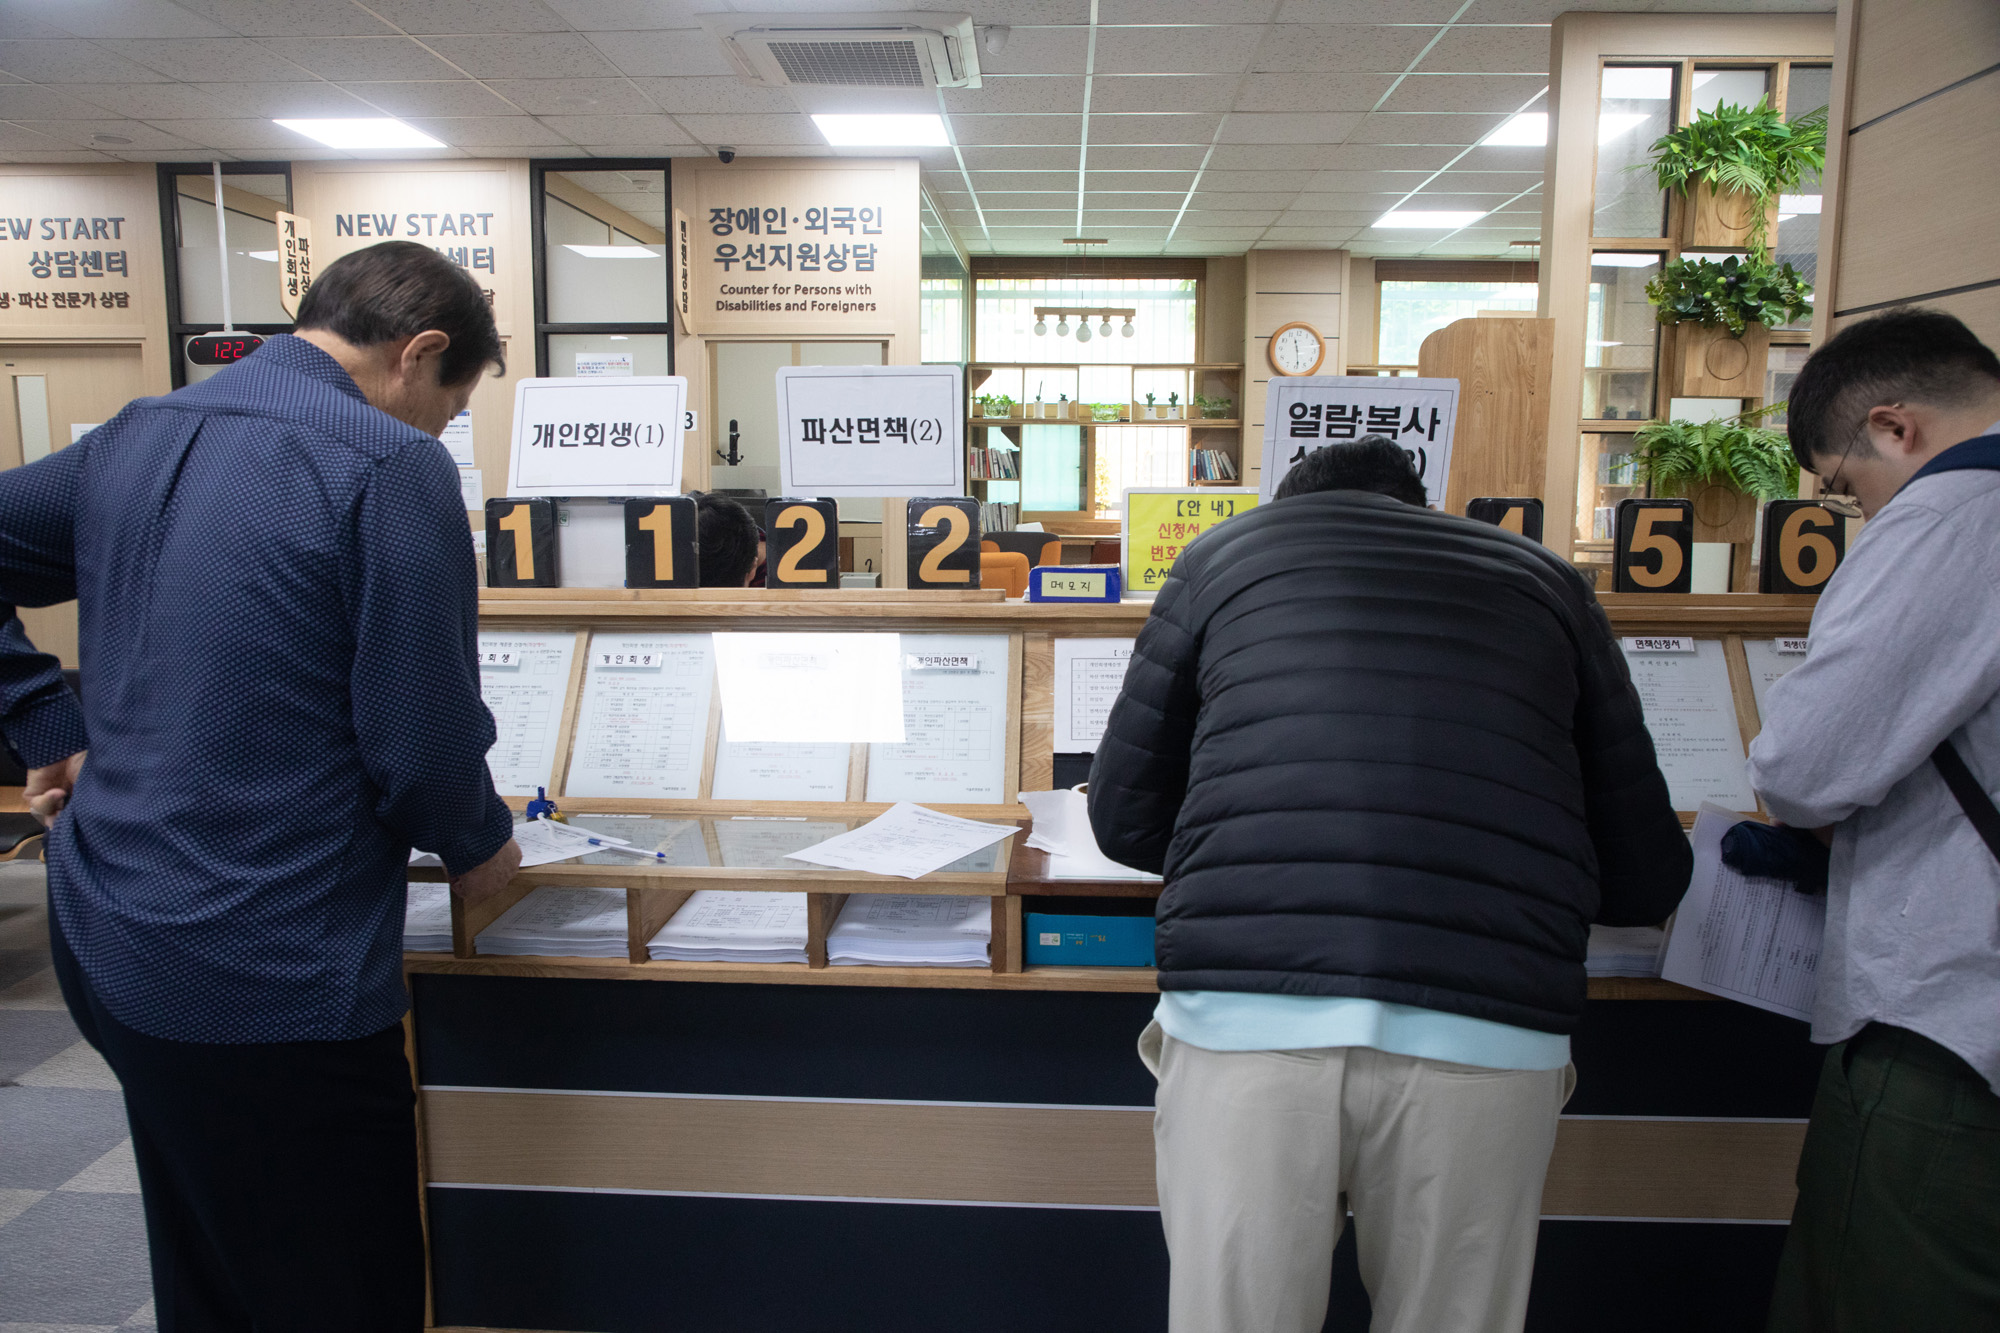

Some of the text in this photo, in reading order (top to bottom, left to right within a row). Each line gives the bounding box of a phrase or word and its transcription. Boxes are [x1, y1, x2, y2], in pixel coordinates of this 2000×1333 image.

[40, 217, 125, 240] START
[336, 213, 493, 237] NEW START
[709, 206, 883, 236] 장애인·외국인
[28, 250, 128, 279] 상담센터
[284, 220, 298, 297] 개인회생
[713, 243, 878, 272] 우선지원상담
[51, 291, 97, 309] 전문가
[100, 291, 130, 309] 상담
[720, 283, 872, 295] Counter for Persons with
[716, 300, 877, 314] Disabilities and Foreigners
[215, 341, 244, 359] 122
[531, 422, 666, 450] 개인회생(1)
[801, 416, 943, 446] 파산면책(2)
[1288, 402, 1441, 442] 열람·복사
[499, 504, 535, 581] 1
[638, 504, 674, 581] 1
[775, 505, 828, 583] 2
[918, 505, 970, 583] 2
[1158, 523, 1200, 540] 신청서
[1628, 507, 1684, 588] 5
[1779, 506, 1837, 587] 6
[1635, 640, 1681, 650] 면책신청서
